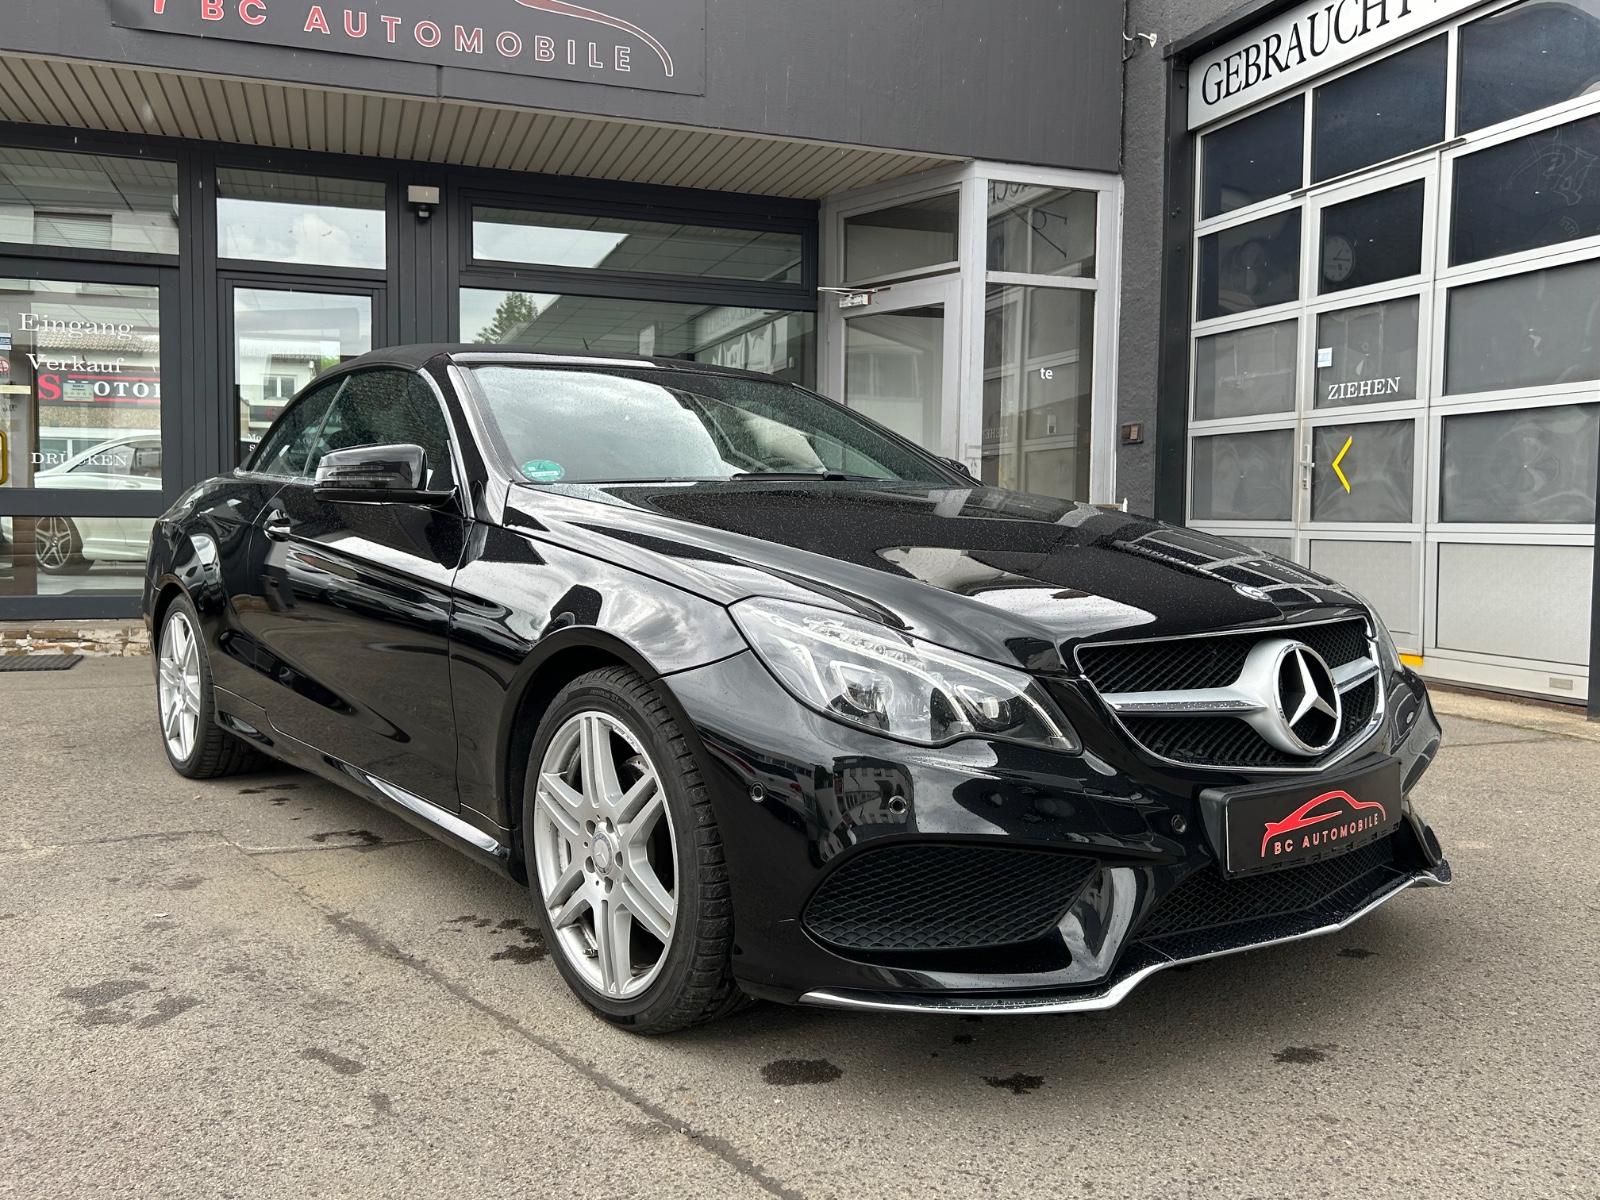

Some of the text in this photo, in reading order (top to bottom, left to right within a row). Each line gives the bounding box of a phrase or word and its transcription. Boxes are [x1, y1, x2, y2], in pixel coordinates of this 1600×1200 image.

[201, 0, 631, 72] BC AUTOMOBILE
[18, 312, 134, 341] Eingang
[26, 353, 125, 373] Verkauf
[1040, 367, 1053, 379] te
[1327, 376, 1401, 400] ZIEHEN
[31, 452, 128, 466] DRÜKEN
[1274, 814, 1379, 855] BC AUTOMOBILE
